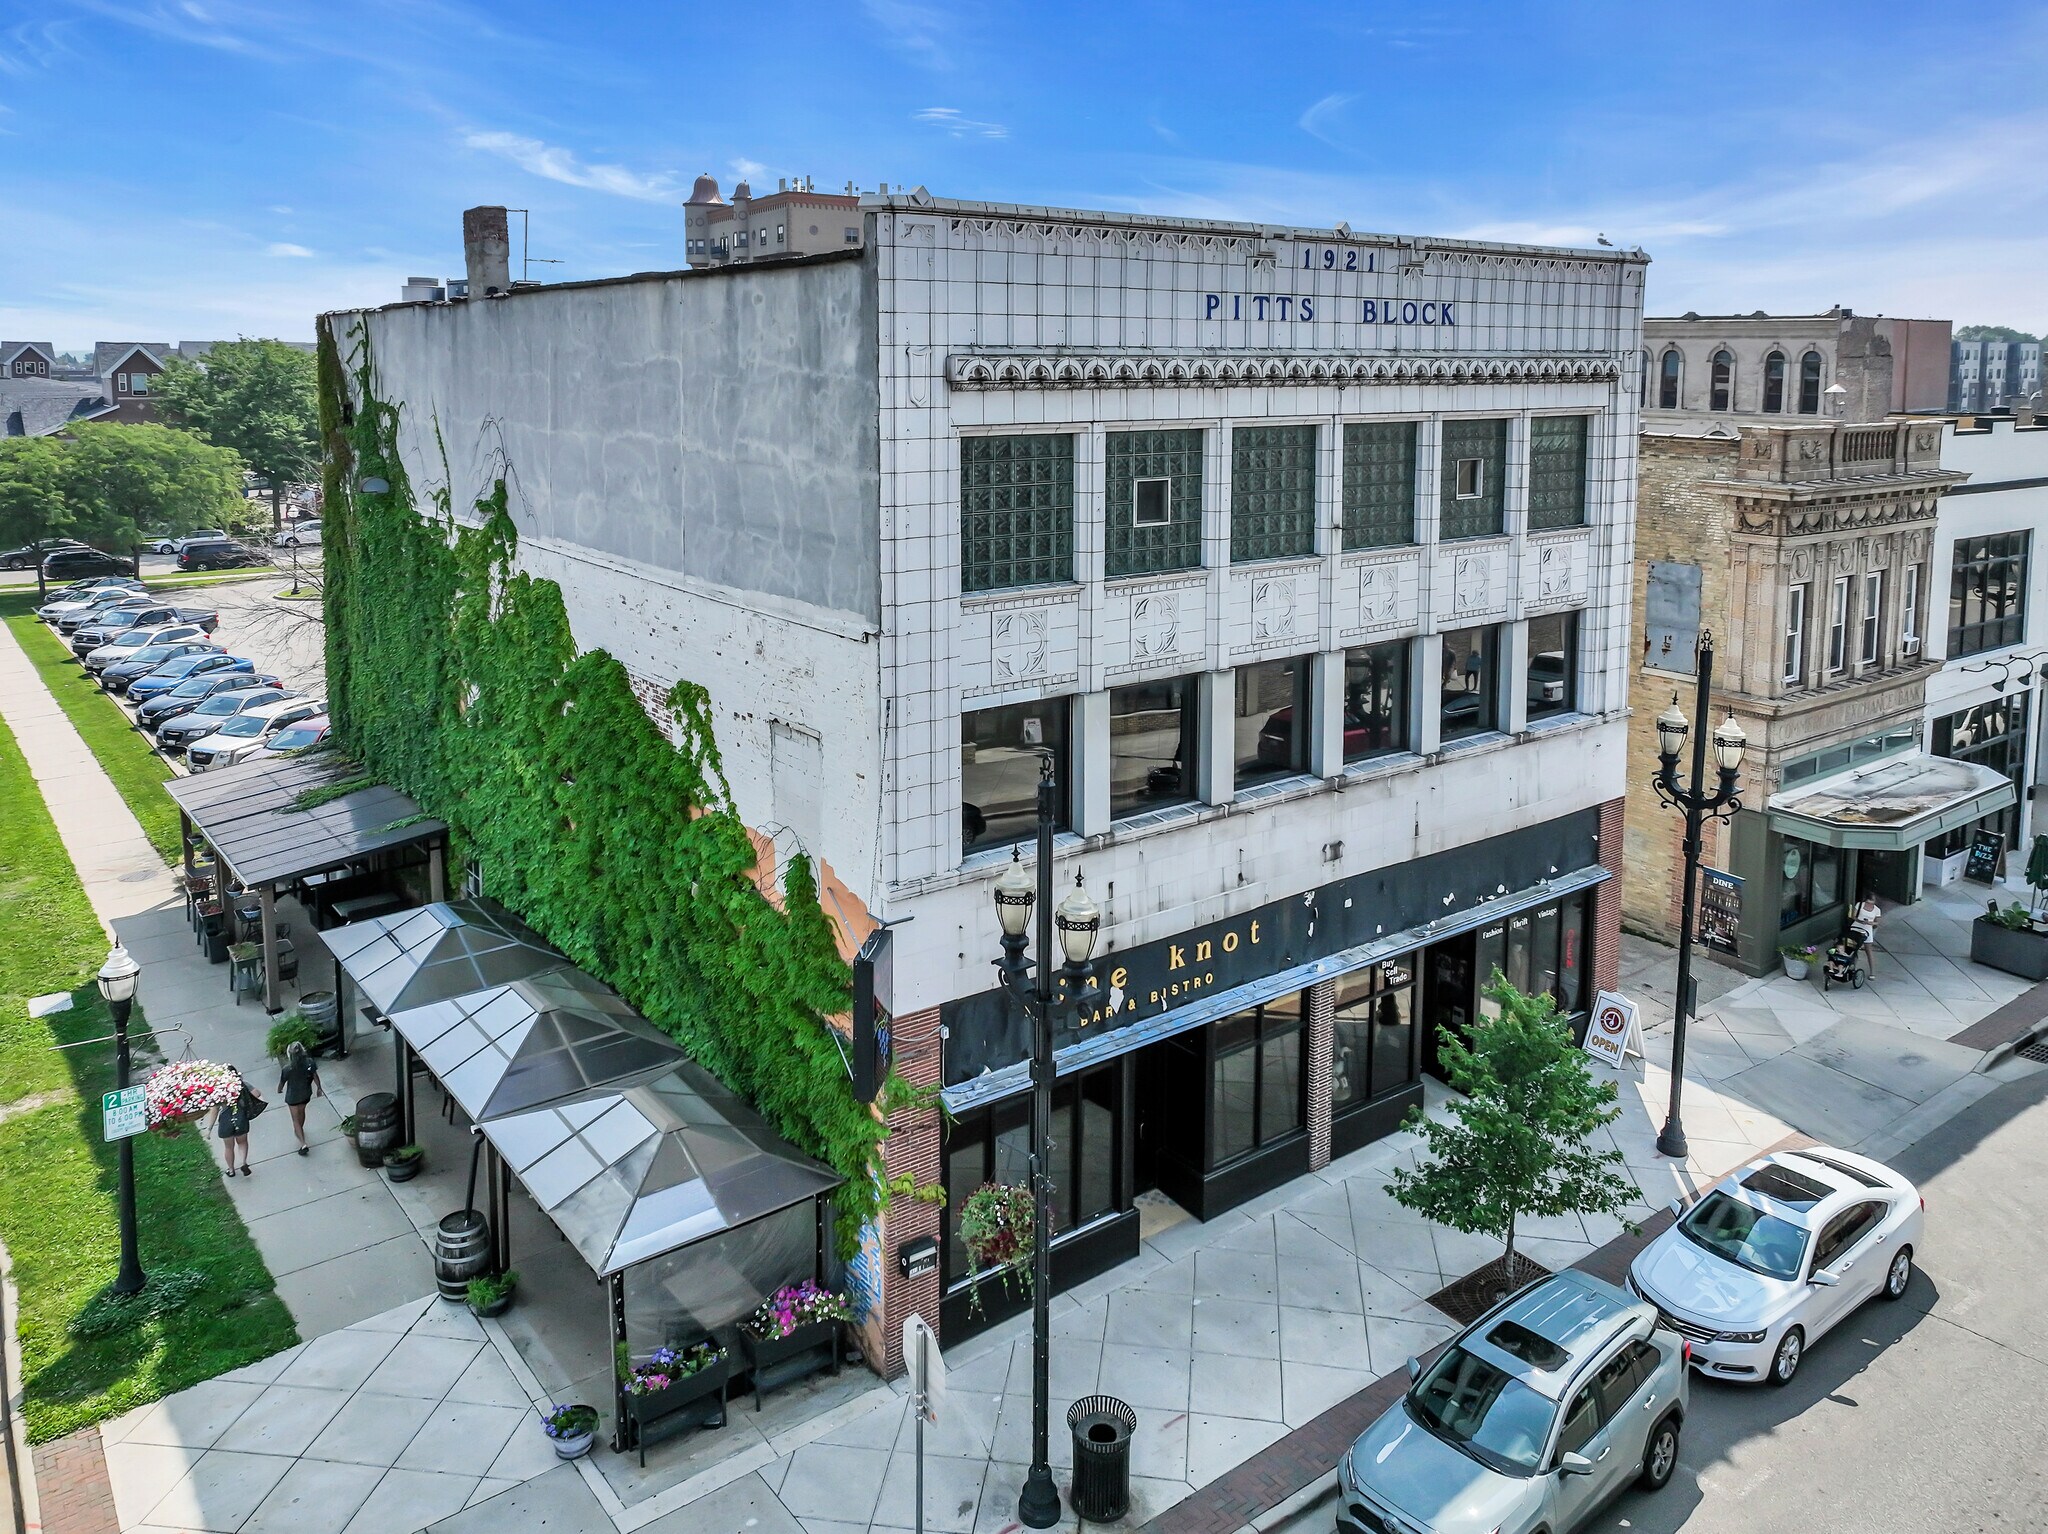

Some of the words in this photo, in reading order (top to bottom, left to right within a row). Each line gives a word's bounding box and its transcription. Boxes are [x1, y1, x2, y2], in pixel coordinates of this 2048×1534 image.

[1303, 248, 1375, 272] 1921
[1206, 294, 1314, 322] PITTS
[1363, 300, 1455, 326] BLOCK
[1976, 843, 1993, 853] THE
[1713, 877, 1734, 890] DINE
[1537, 907, 1558, 919] Vintage
[1513, 917, 1528, 929] Thrift
[1482, 927, 1504, 940] Fashion
[1168, 919, 1260, 971] knot
[1381, 959, 1395, 969] Buy
[1385, 966, 1398, 978] Sell
[1389, 972, 1408, 985] Trade
[1080, 1006, 1114, 1028] BAR
[1128, 997, 1136, 1011] &
[1150, 972, 1214, 1003] BISTRO
[1591, 1034, 1620, 1055] OPEN
[108, 1094, 118, 1108] 2
[108, 1117, 116, 1126] TO
